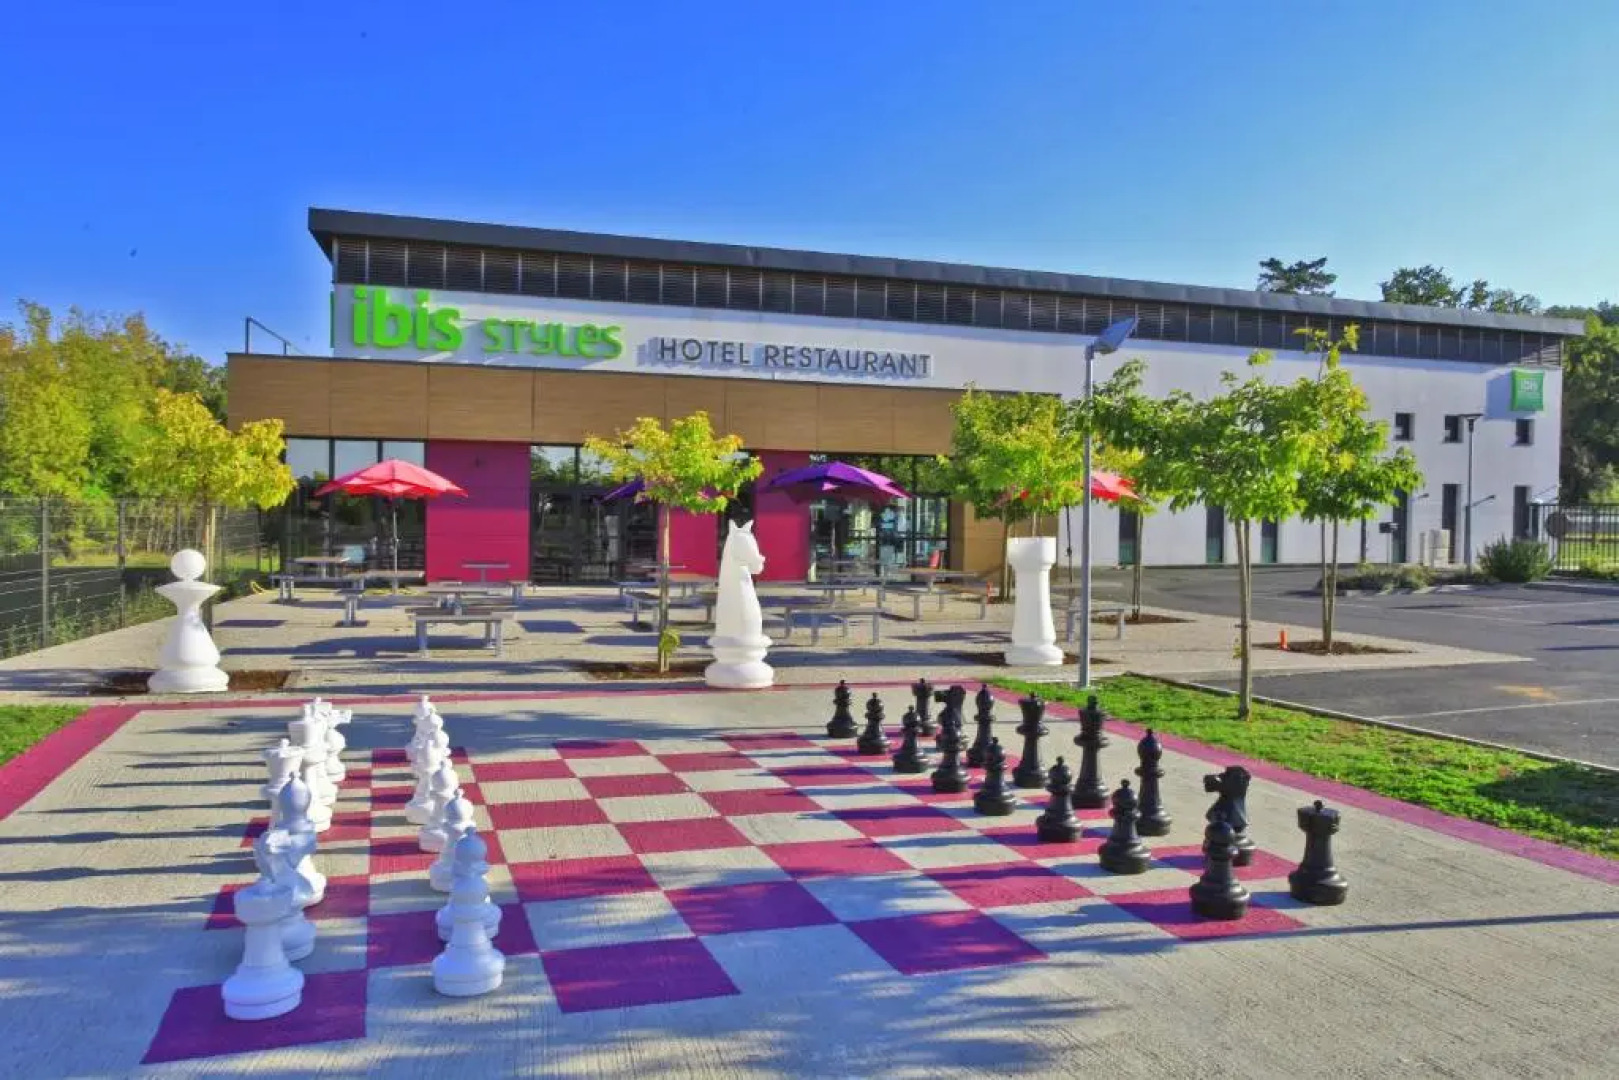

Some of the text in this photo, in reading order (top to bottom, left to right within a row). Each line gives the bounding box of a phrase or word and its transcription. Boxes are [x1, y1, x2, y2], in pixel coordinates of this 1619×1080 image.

[353, 285, 462, 350] ibis
[659, 337, 931, 374] HOTEL RESTAURANT
